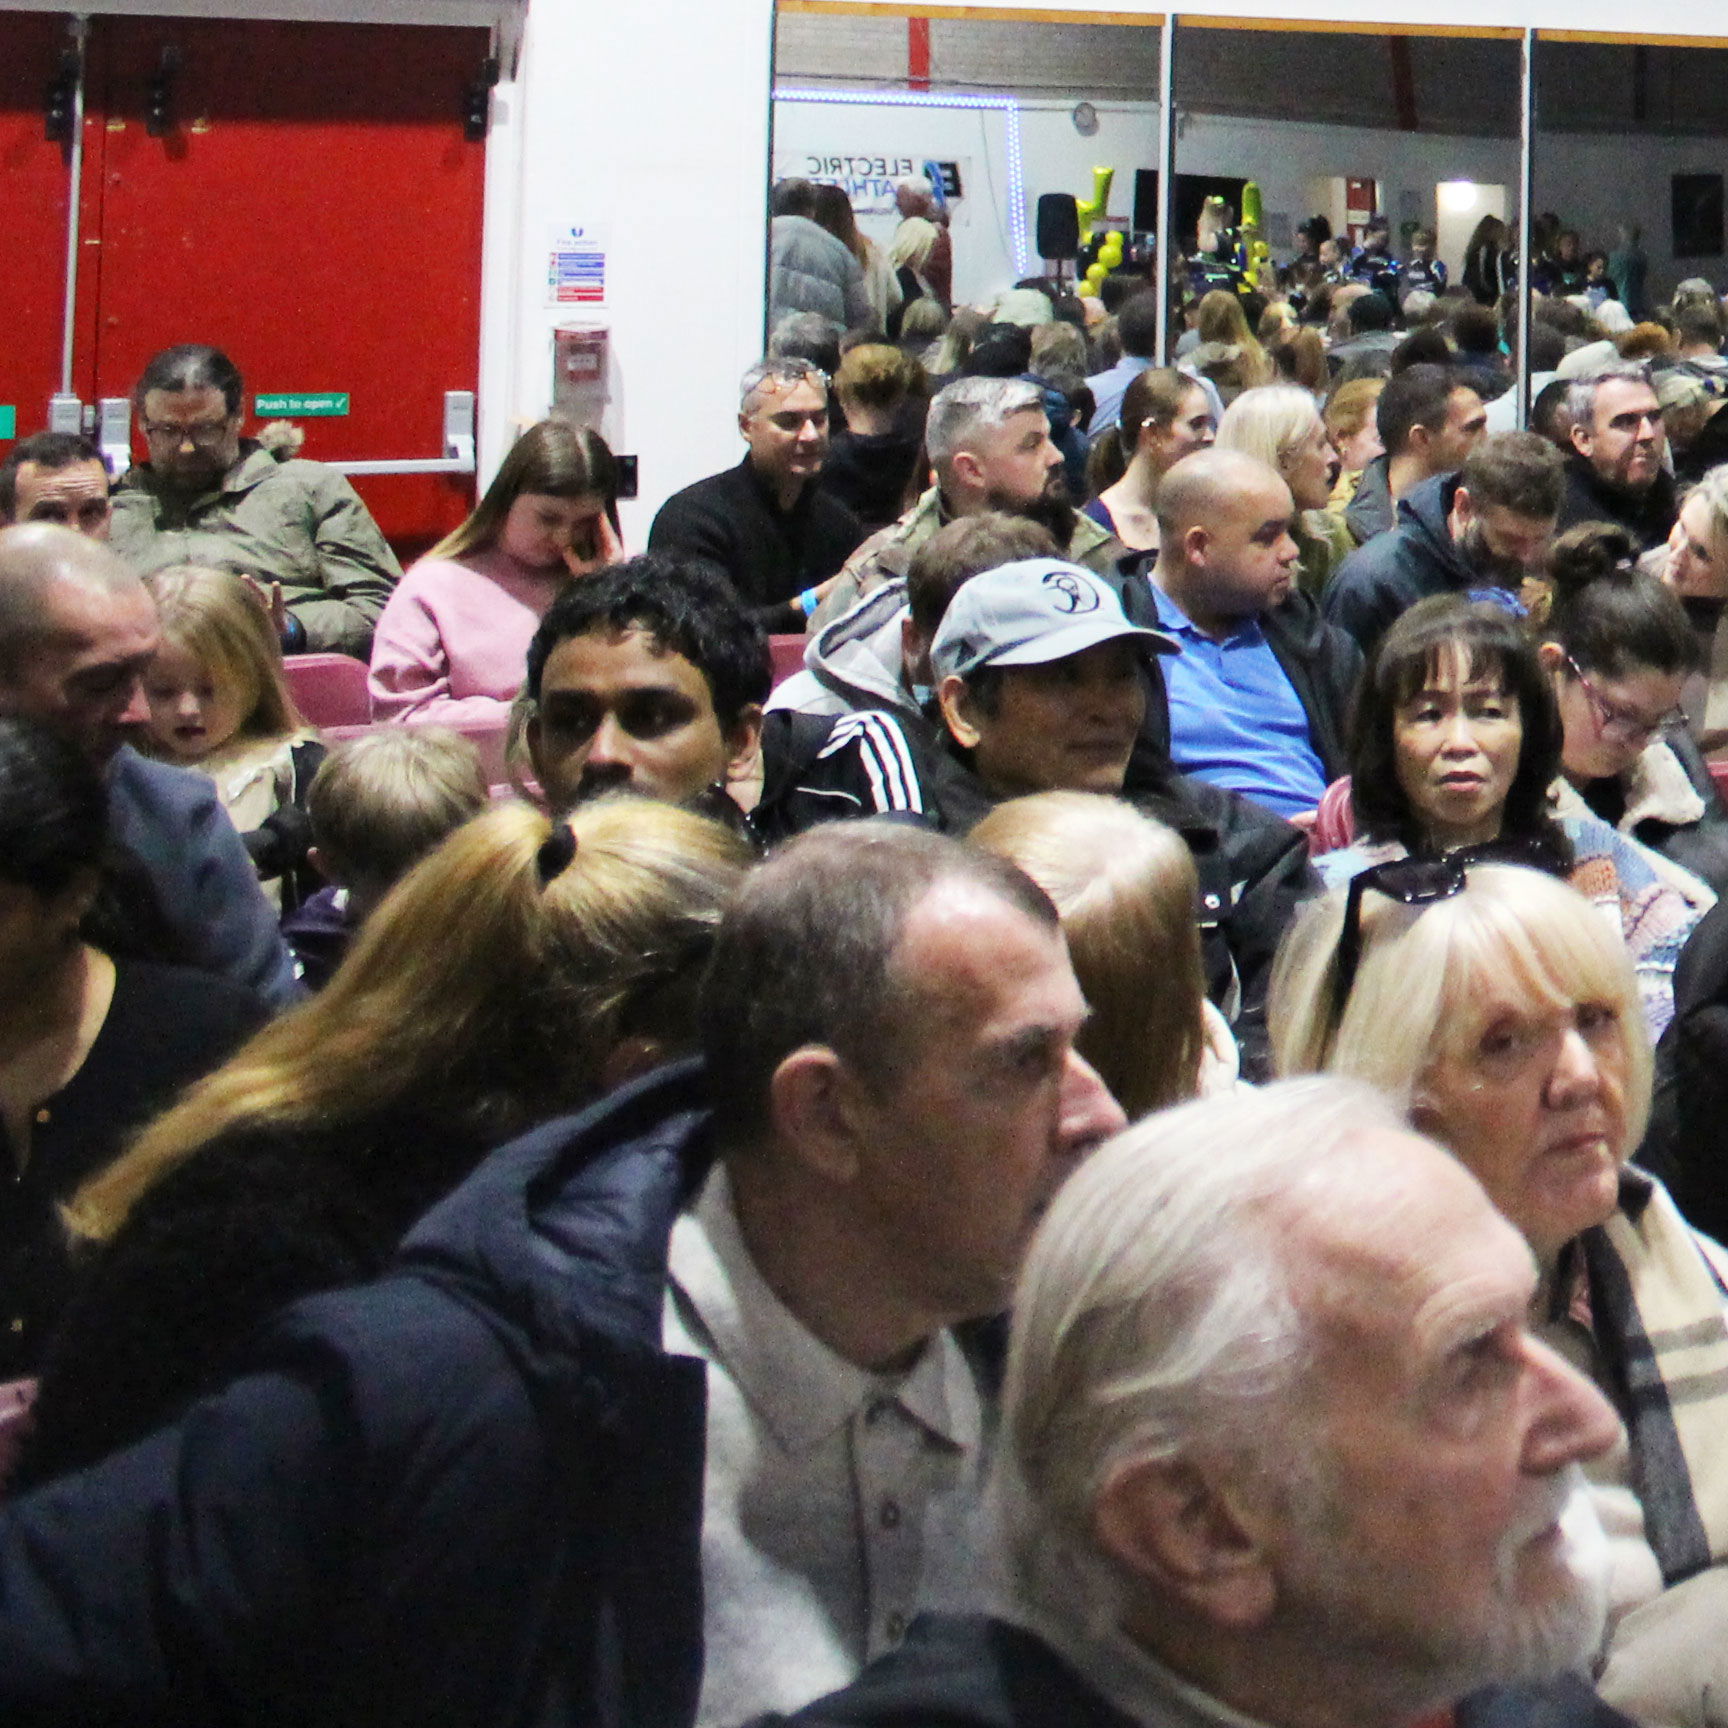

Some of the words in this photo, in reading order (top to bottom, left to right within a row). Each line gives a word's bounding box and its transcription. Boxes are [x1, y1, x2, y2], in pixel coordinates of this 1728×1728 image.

[256, 398, 287, 410] Push
[288, 399, 301, 409] to
[303, 399, 333, 411] open
